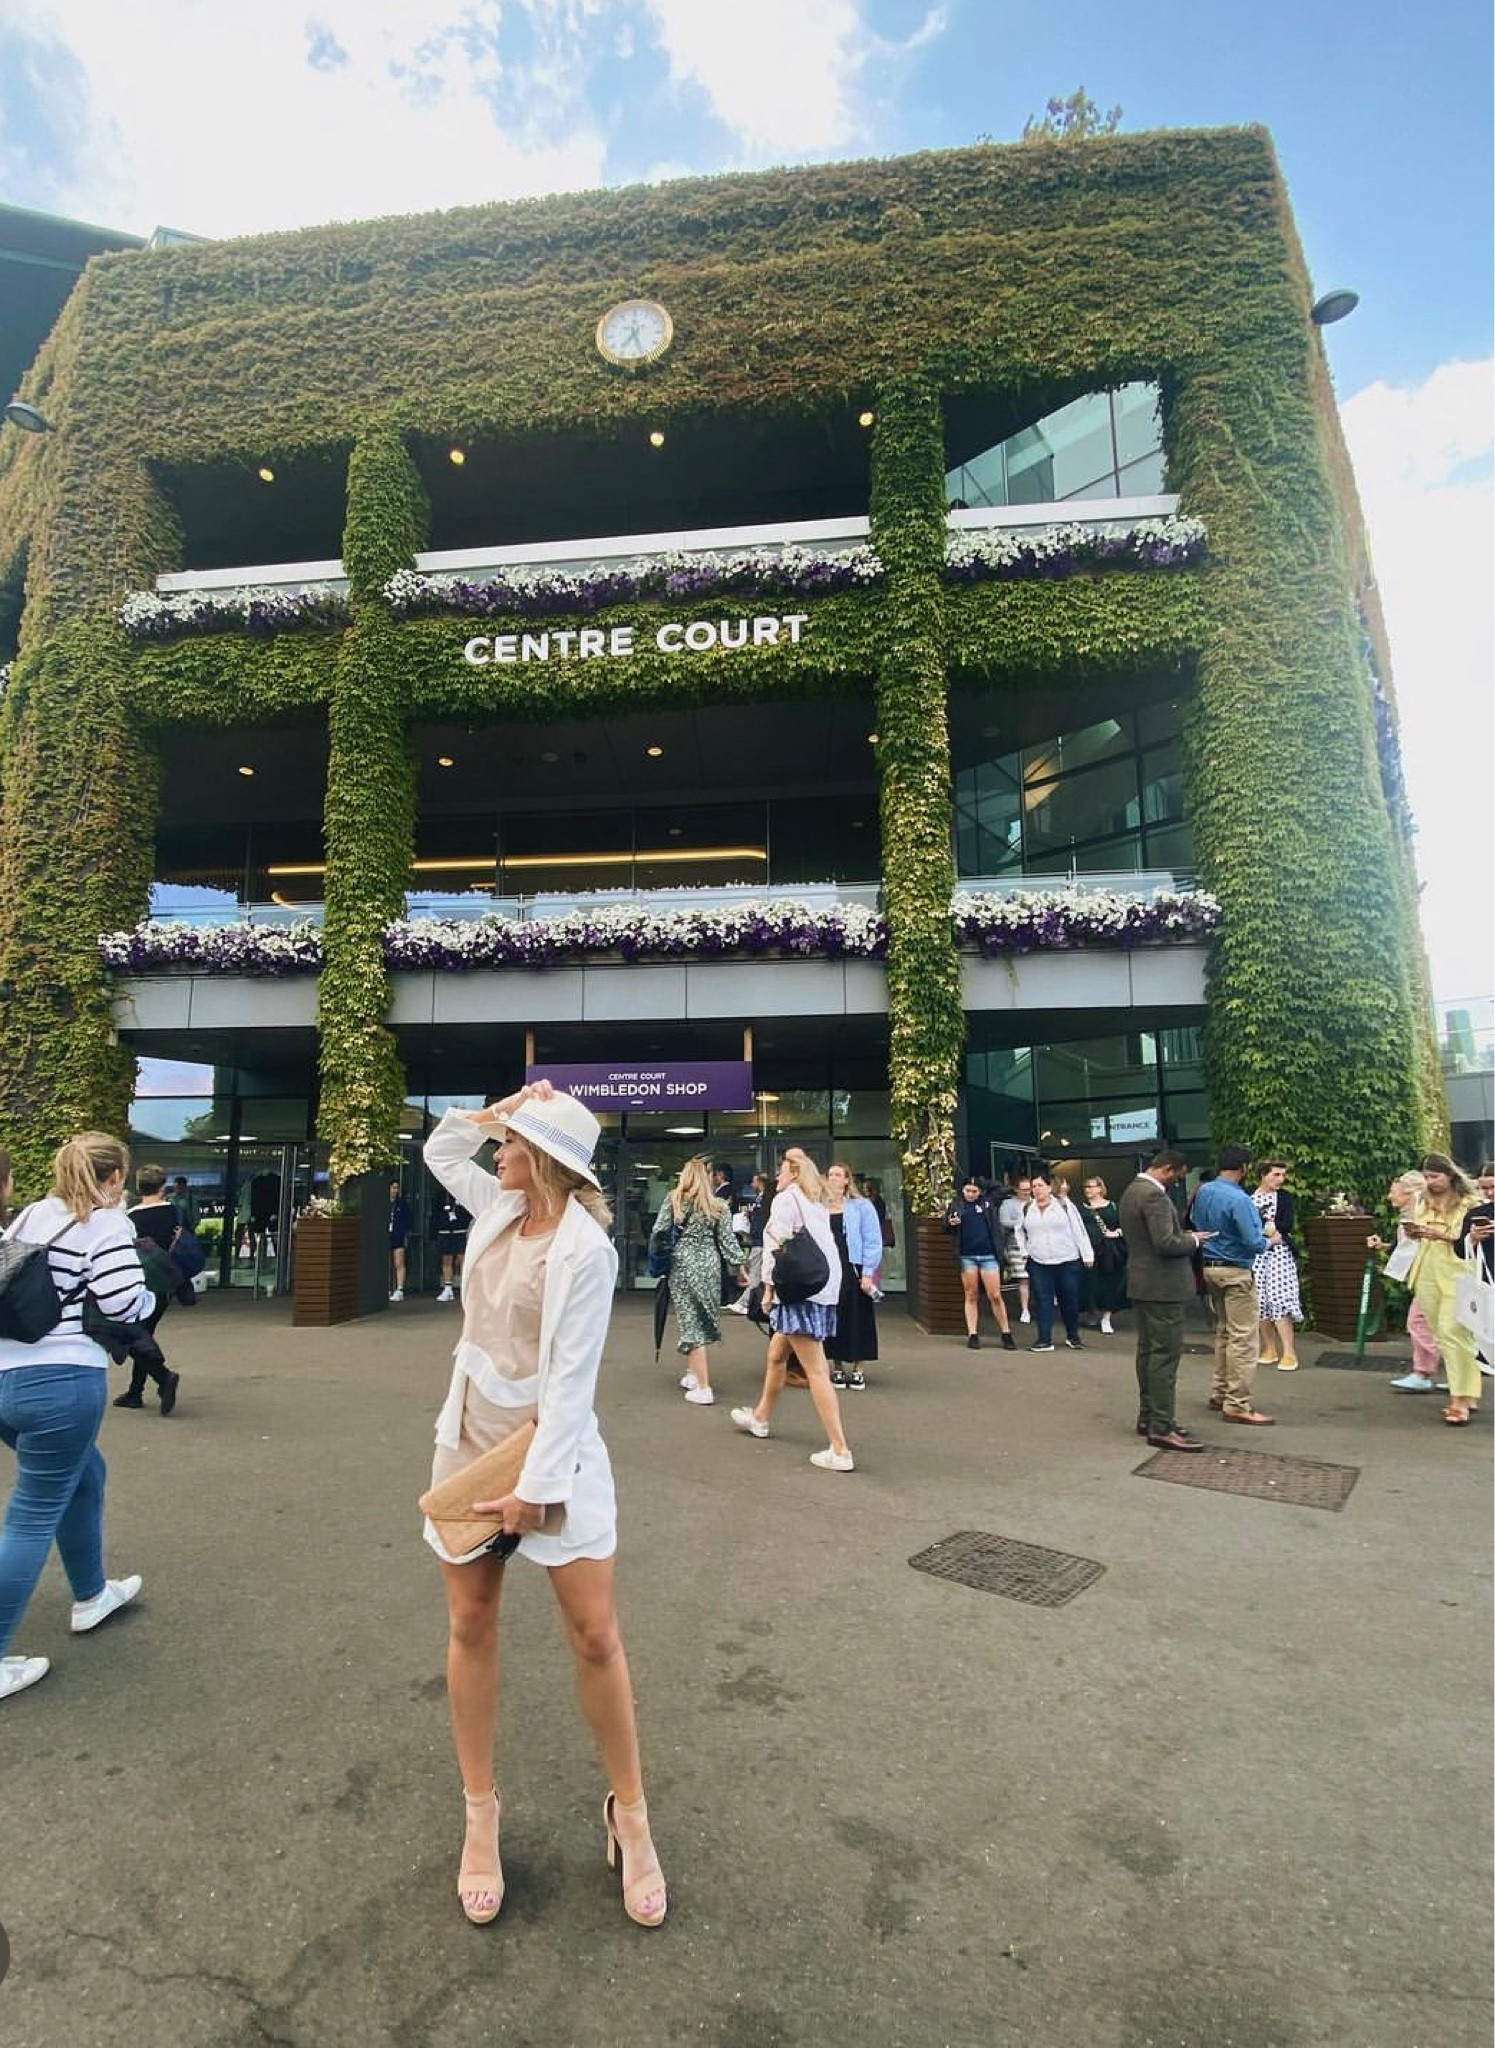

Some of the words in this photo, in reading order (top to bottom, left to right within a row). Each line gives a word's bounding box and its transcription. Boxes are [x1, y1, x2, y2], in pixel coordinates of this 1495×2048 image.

[464, 627, 634, 665] CENTRE
[656, 614, 808, 651] COURT
[608, 1073, 638, 1081] CENTRE
[640, 1072, 666, 1080] COURT
[569, 1084, 660, 1096] WIMBLEDON
[666, 1083, 708, 1095] SHOP
[1109, 1121, 1149, 1131] NTRANCE
